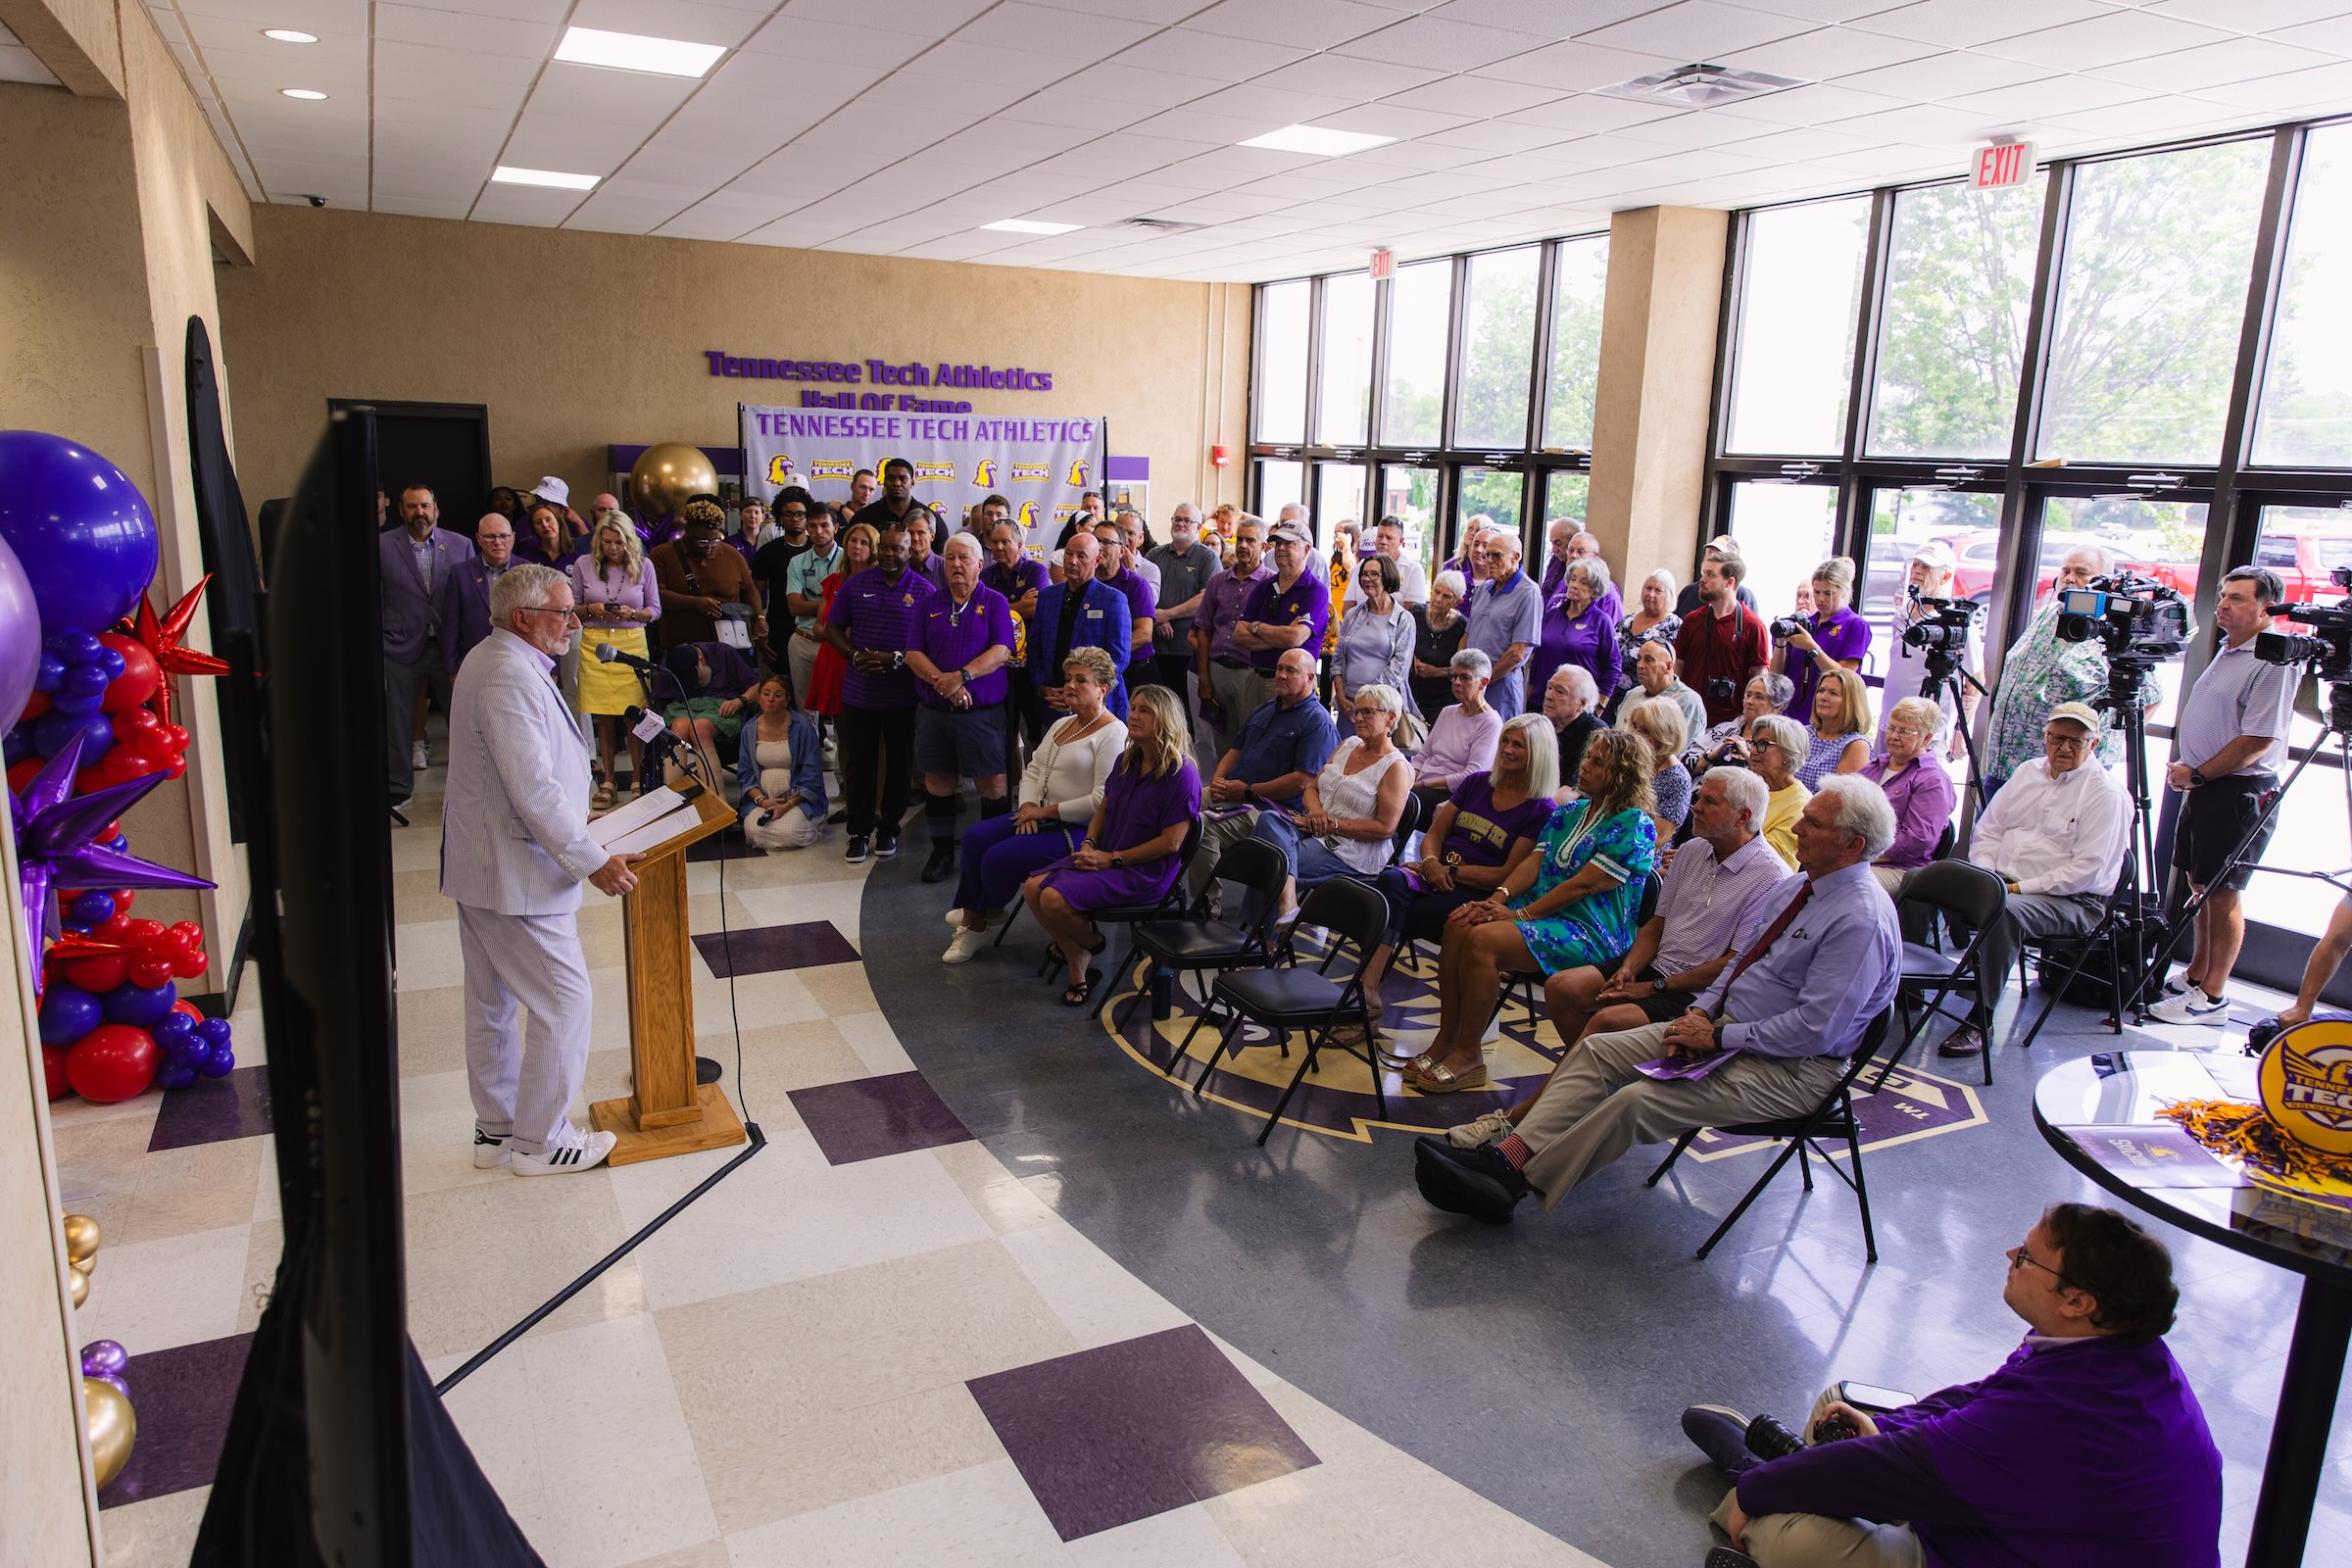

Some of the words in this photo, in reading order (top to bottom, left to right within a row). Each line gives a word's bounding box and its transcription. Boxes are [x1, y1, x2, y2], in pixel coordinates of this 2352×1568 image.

[1978, 143, 2026, 187] EXIT
[1373, 251, 1391, 277] EXIT
[705, 350, 862, 384] Tennessee
[866, 359, 930, 386] Tech
[935, 363, 1053, 391] Athletics
[801, 390, 857, 410] Hall
[861, 392, 895, 412] Of
[899, 394, 973, 414] Fame
[756, 413, 902, 440] TENNESSEE
[907, 417, 969, 441] TECH
[974, 419, 1094, 444] ATHLETICS
[811, 466, 854, 477] TECH
[915, 467, 955, 478] TECH
[1011, 468, 1050, 478] TECH
